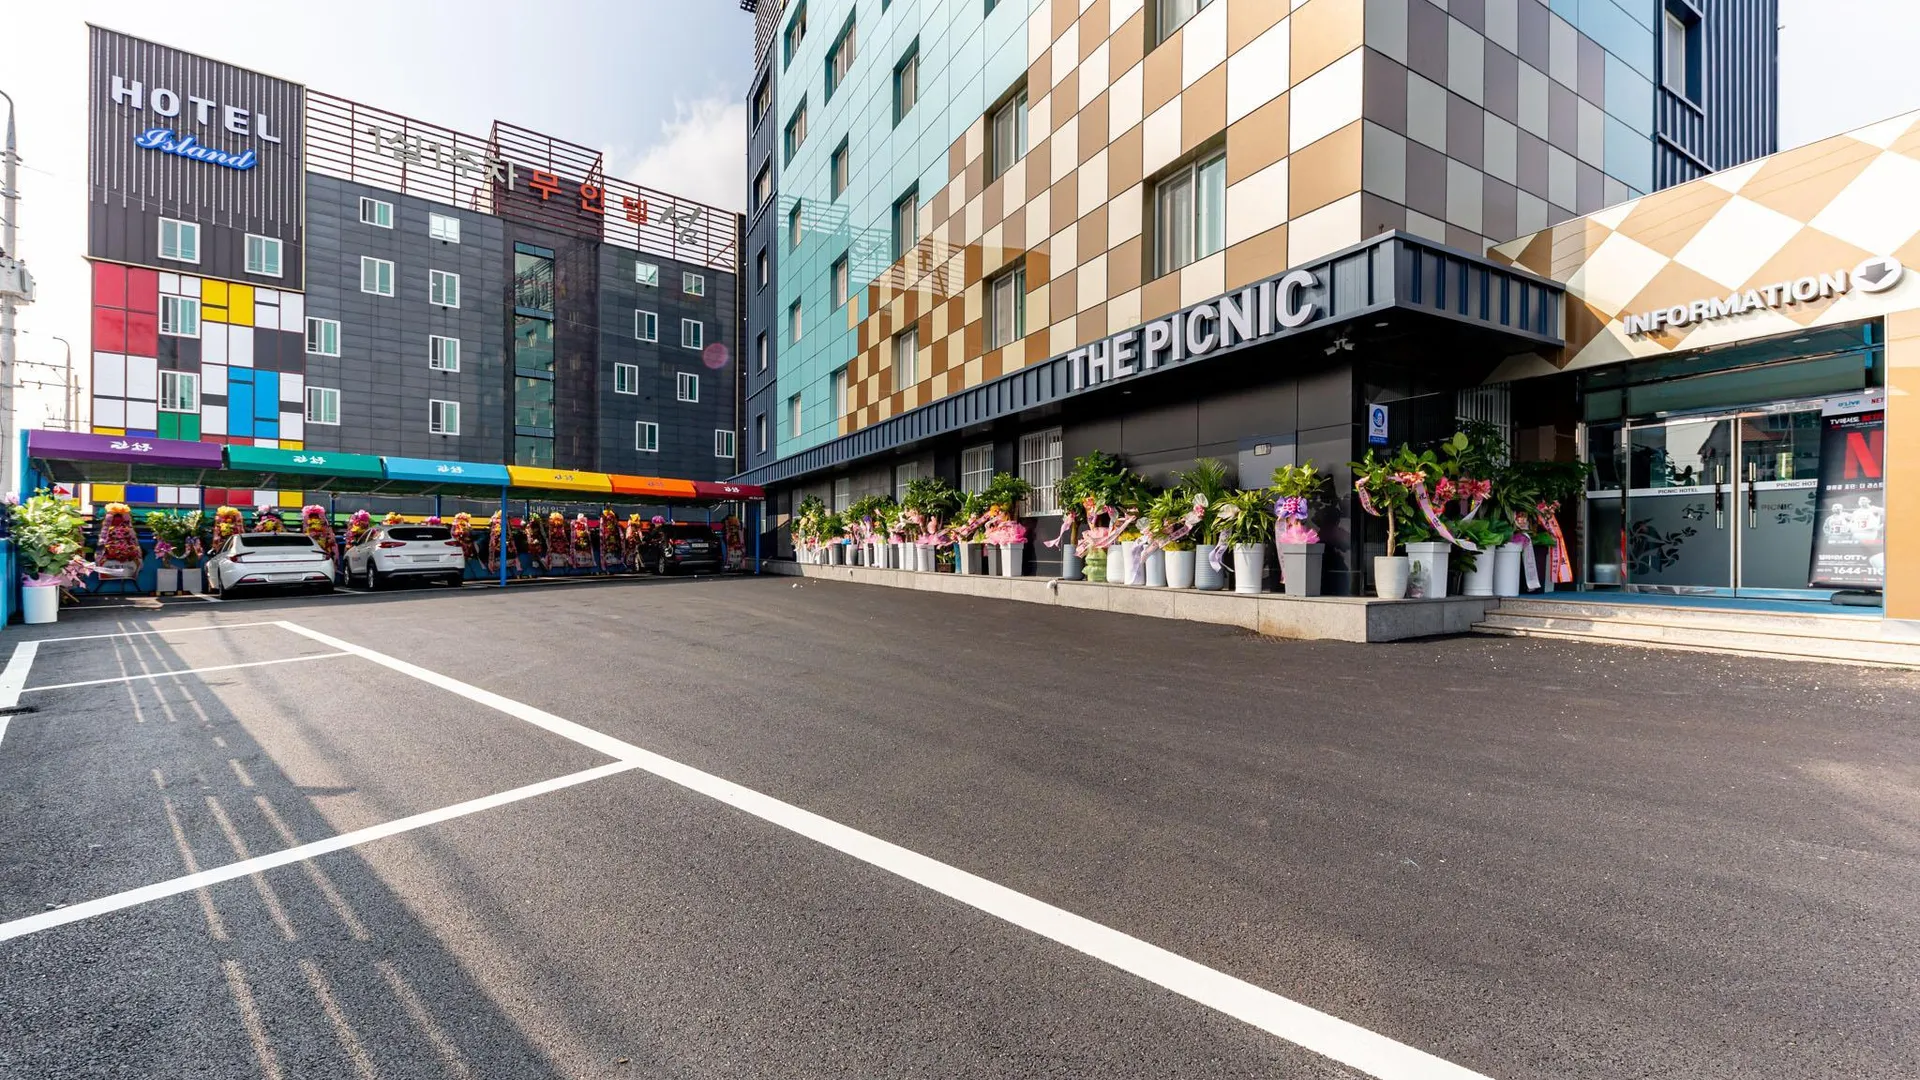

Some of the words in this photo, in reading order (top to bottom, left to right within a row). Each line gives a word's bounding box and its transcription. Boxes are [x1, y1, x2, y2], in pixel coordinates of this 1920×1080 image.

[112, 75, 281, 144] HOTEL
[134, 126, 259, 171] Island
[528, 169, 649, 225] 무인텔
[657, 206, 703, 246] 섬
[1067, 331, 1138, 391] THE
[1144, 269, 1319, 369] PICNIC
[1623, 268, 1849, 337] INFORMATION
[1844, 430, 1884, 480] N
[1761, 503, 1794, 511] PICNIC
[1776, 481, 1801, 489] PICNIC
